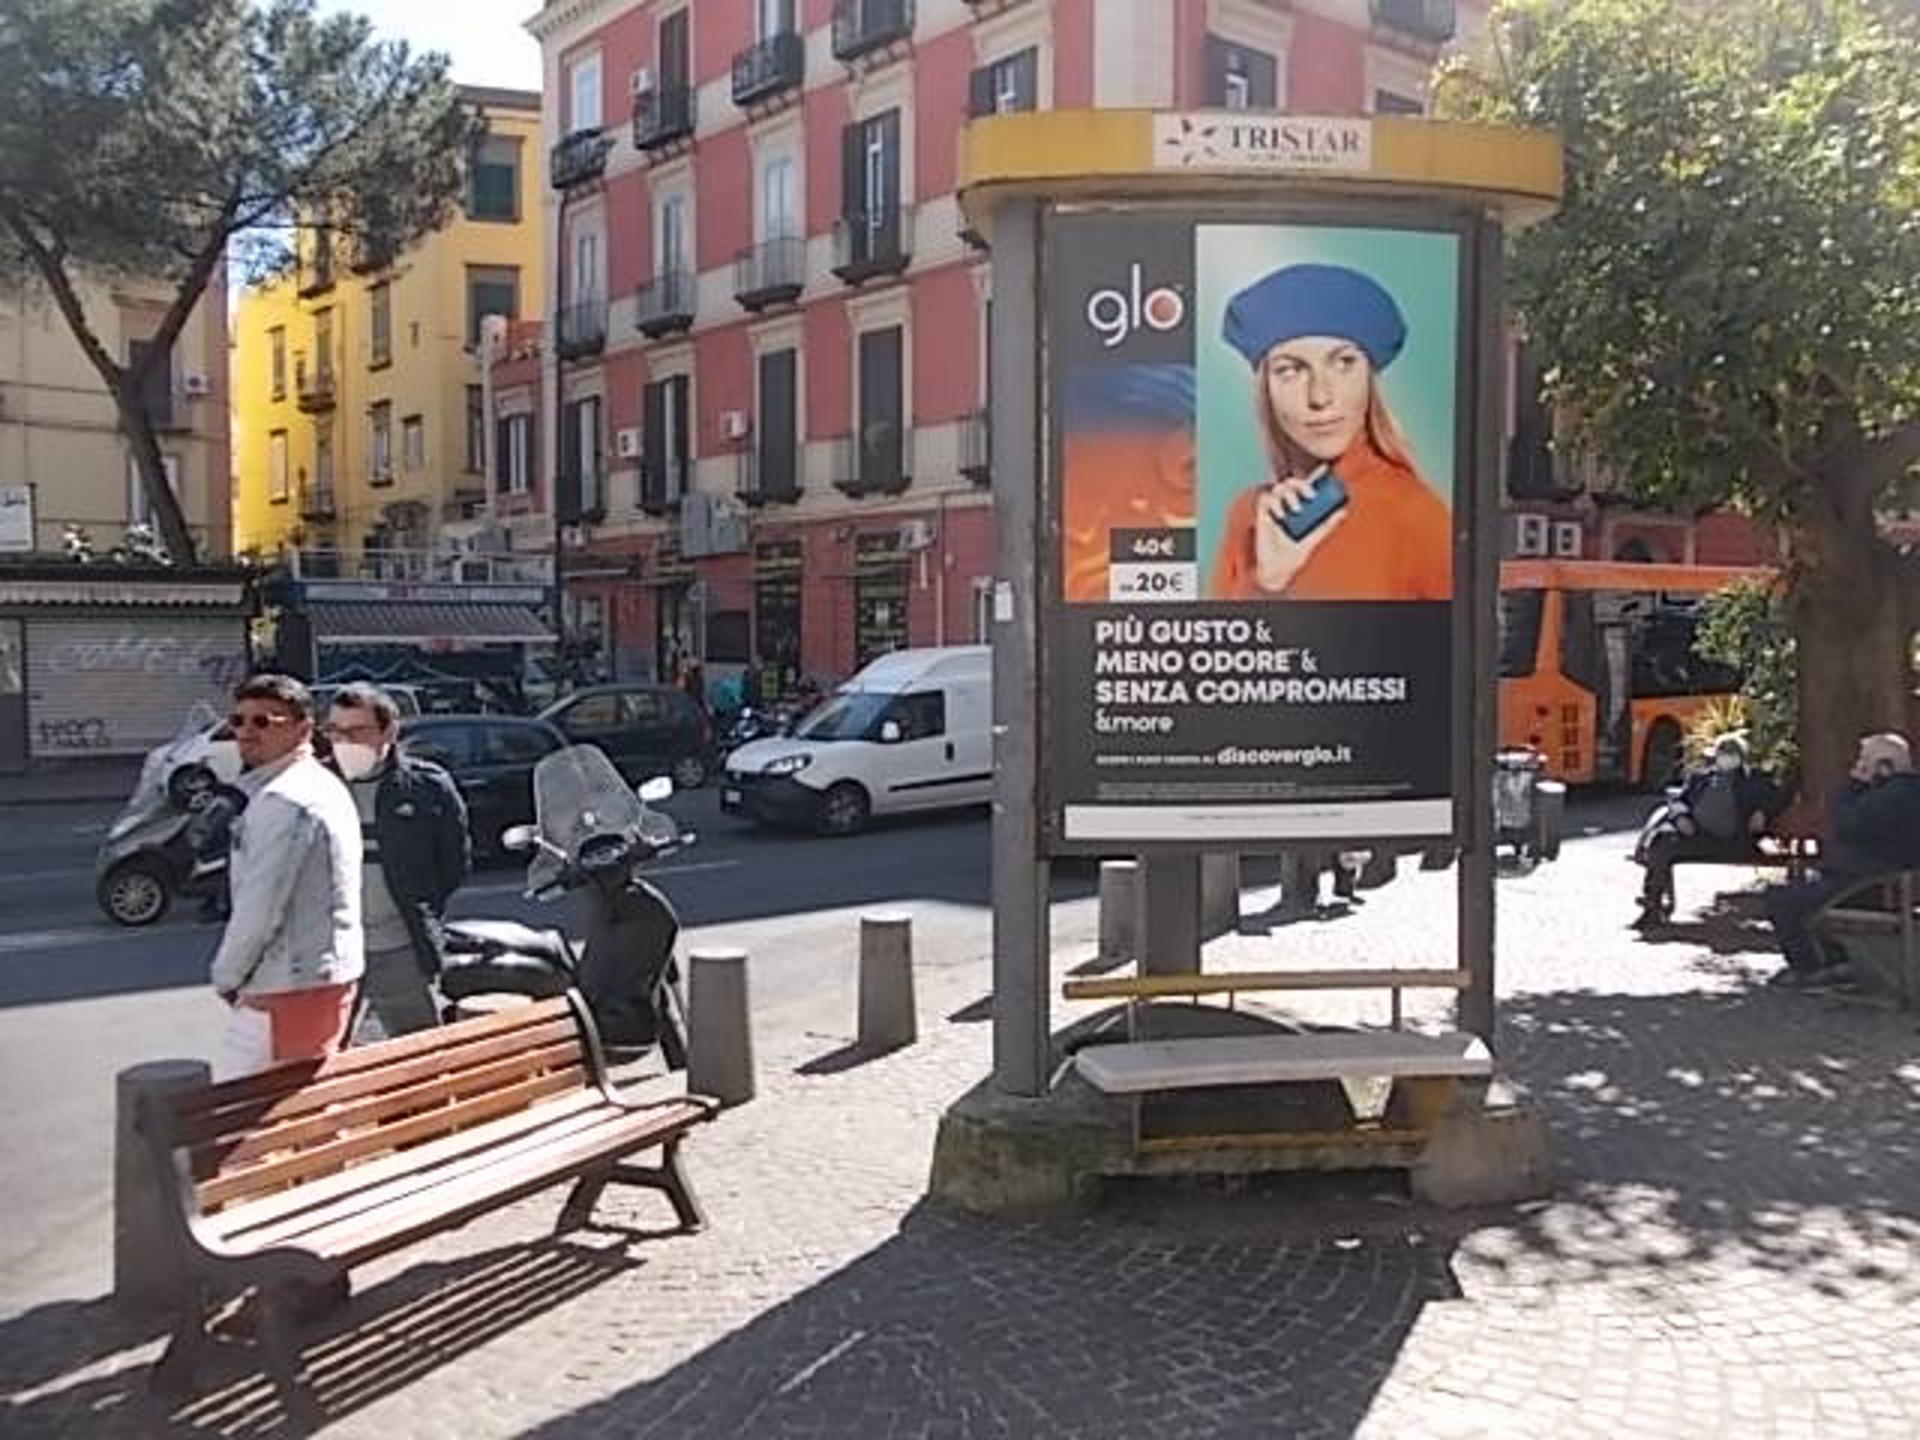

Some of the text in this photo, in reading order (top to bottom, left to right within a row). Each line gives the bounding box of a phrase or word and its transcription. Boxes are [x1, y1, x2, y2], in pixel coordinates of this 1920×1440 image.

[1227, 124, 1361, 151] TRISTAR
[1087, 263, 1184, 347] glo
[1095, 613, 1273, 644] PIÙ GUSTO &
[1094, 650, 1184, 674] MENO
[1301, 647, 1319, 673] &
[1095, 676, 1406, 704] SENZA COMPROMESSI
